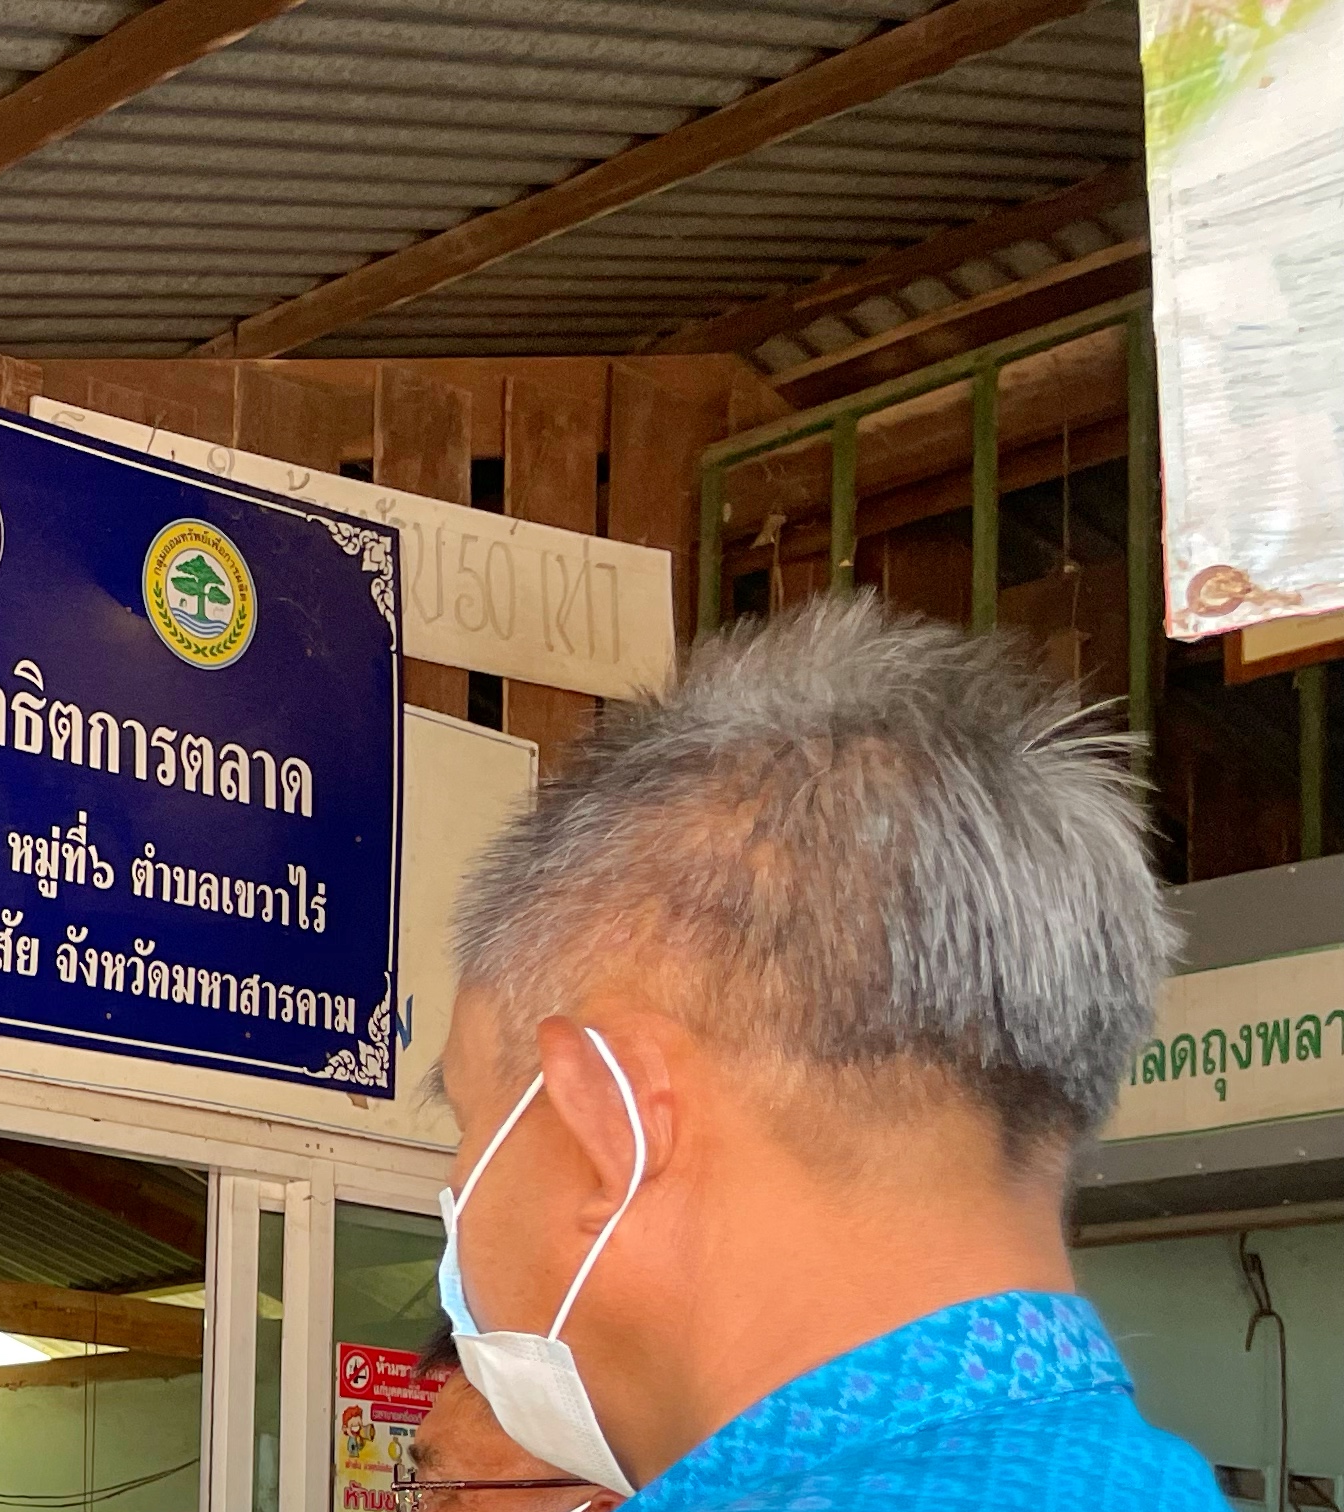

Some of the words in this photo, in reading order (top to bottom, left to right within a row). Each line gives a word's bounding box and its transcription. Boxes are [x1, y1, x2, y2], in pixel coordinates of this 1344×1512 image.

[131, 844, 327, 934] ตำบลเขวาไร่
[56, 927, 356, 1036] จังหวัดมหาสารคาม
